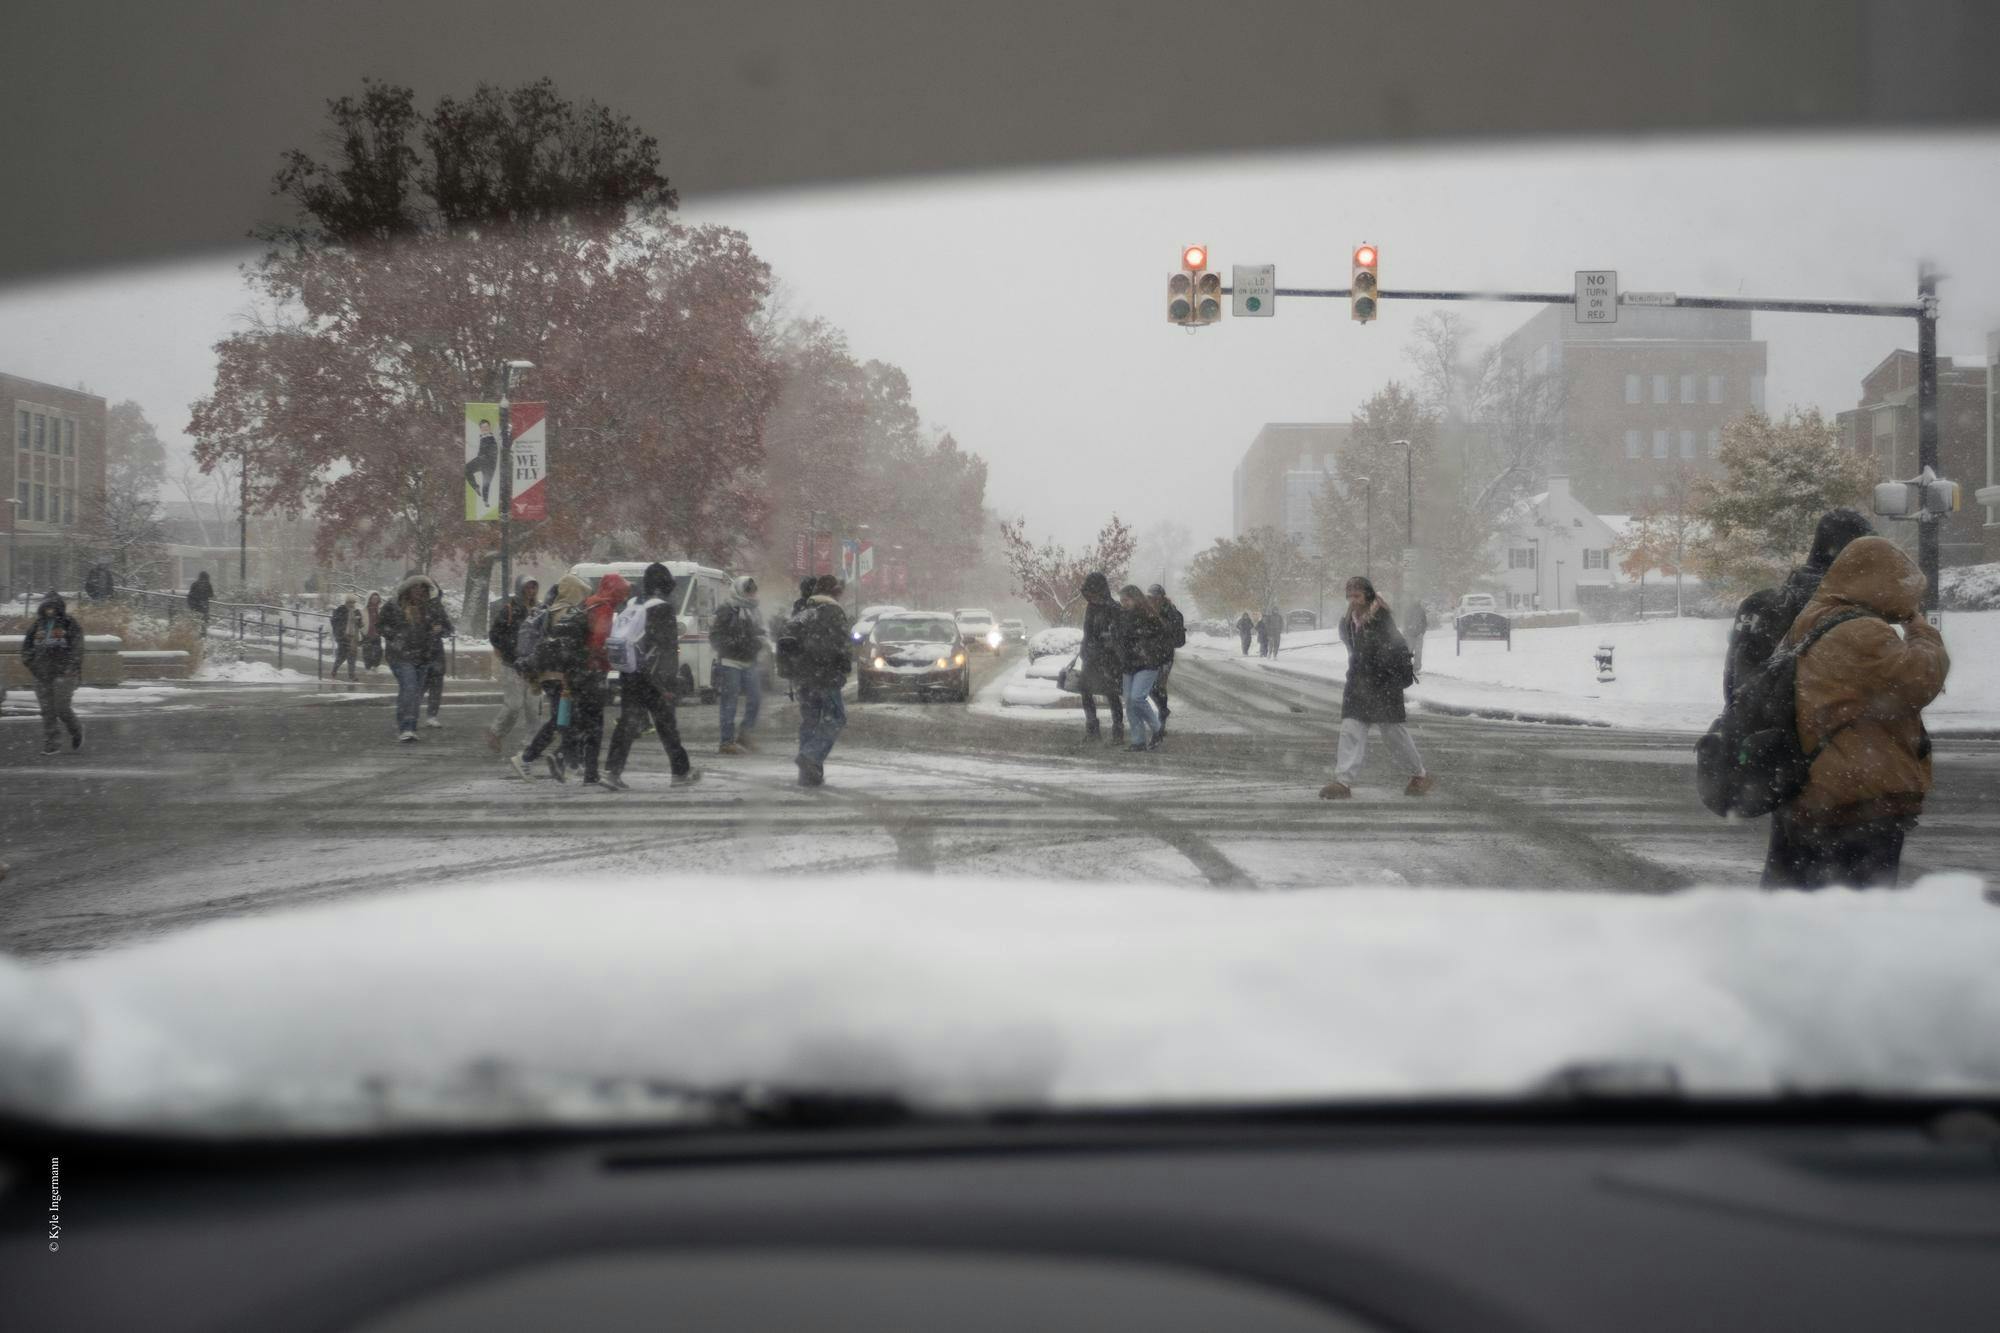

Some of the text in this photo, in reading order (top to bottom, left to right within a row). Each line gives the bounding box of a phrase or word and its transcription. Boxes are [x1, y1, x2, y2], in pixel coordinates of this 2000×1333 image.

[1587, 275, 1605, 285] NO
[1585, 288, 1607, 297] TURN
[1590, 299, 1602, 308] ON
[1587, 310, 1605, 320] RED
[517, 455, 537, 467] WE
[517, 468, 539, 480] FLY
